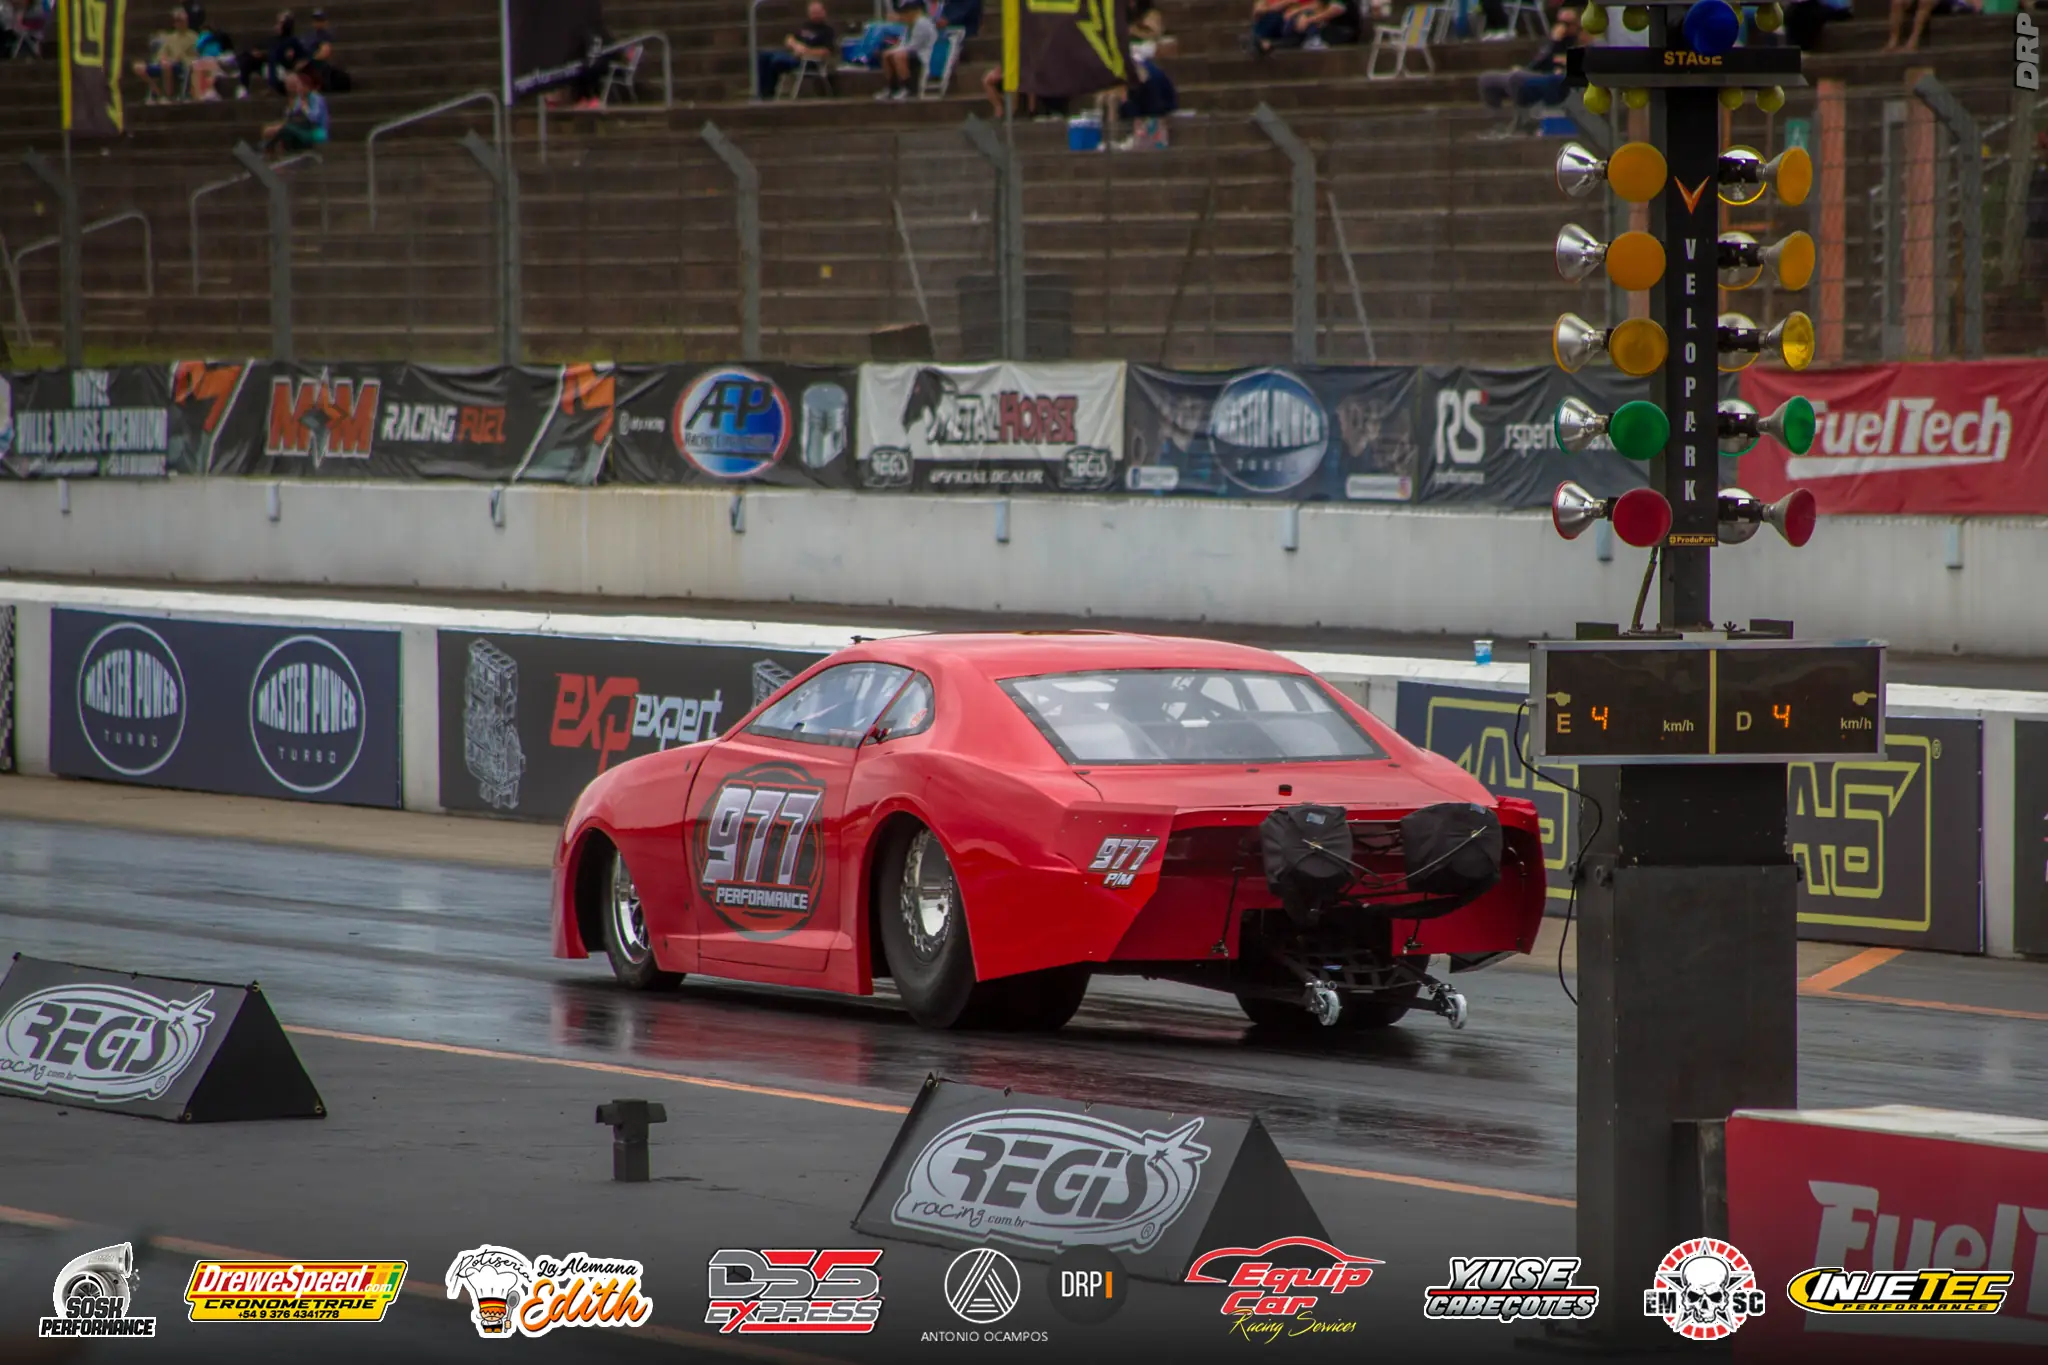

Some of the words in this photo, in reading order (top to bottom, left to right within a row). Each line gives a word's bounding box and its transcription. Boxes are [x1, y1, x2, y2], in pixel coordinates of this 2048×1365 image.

[1664, 51, 1723, 66] STAGE
[1685, 238, 1697, 501] VELOPARK
[381, 403, 455, 443] RACING
[458, 406, 507, 443] FUEL
[1436, 390, 1489, 463] RS
[990, 469, 1043, 484] DEALER
[85, 648, 132, 718] MASTER
[135, 648, 178, 719] POWER
[258, 663, 308, 733] MASTER
[312, 663, 357, 733] POWER
[631, 689, 723, 750] expert
[1557, 713, 1571, 733] E
[1591, 706, 1608, 730] 4
[1663, 719, 1694, 732] km/h
[1736, 712, 1752, 731] D
[1772, 704, 1791, 728] 4
[1840, 717, 1872, 730] km/h
[104, 729, 158, 747] TURBO
[278, 745, 336, 764] TURBO
[703, 786, 824, 885] 977
[1088, 836, 1159, 871] 977
[716, 887, 808, 910] PERFORMANCE
